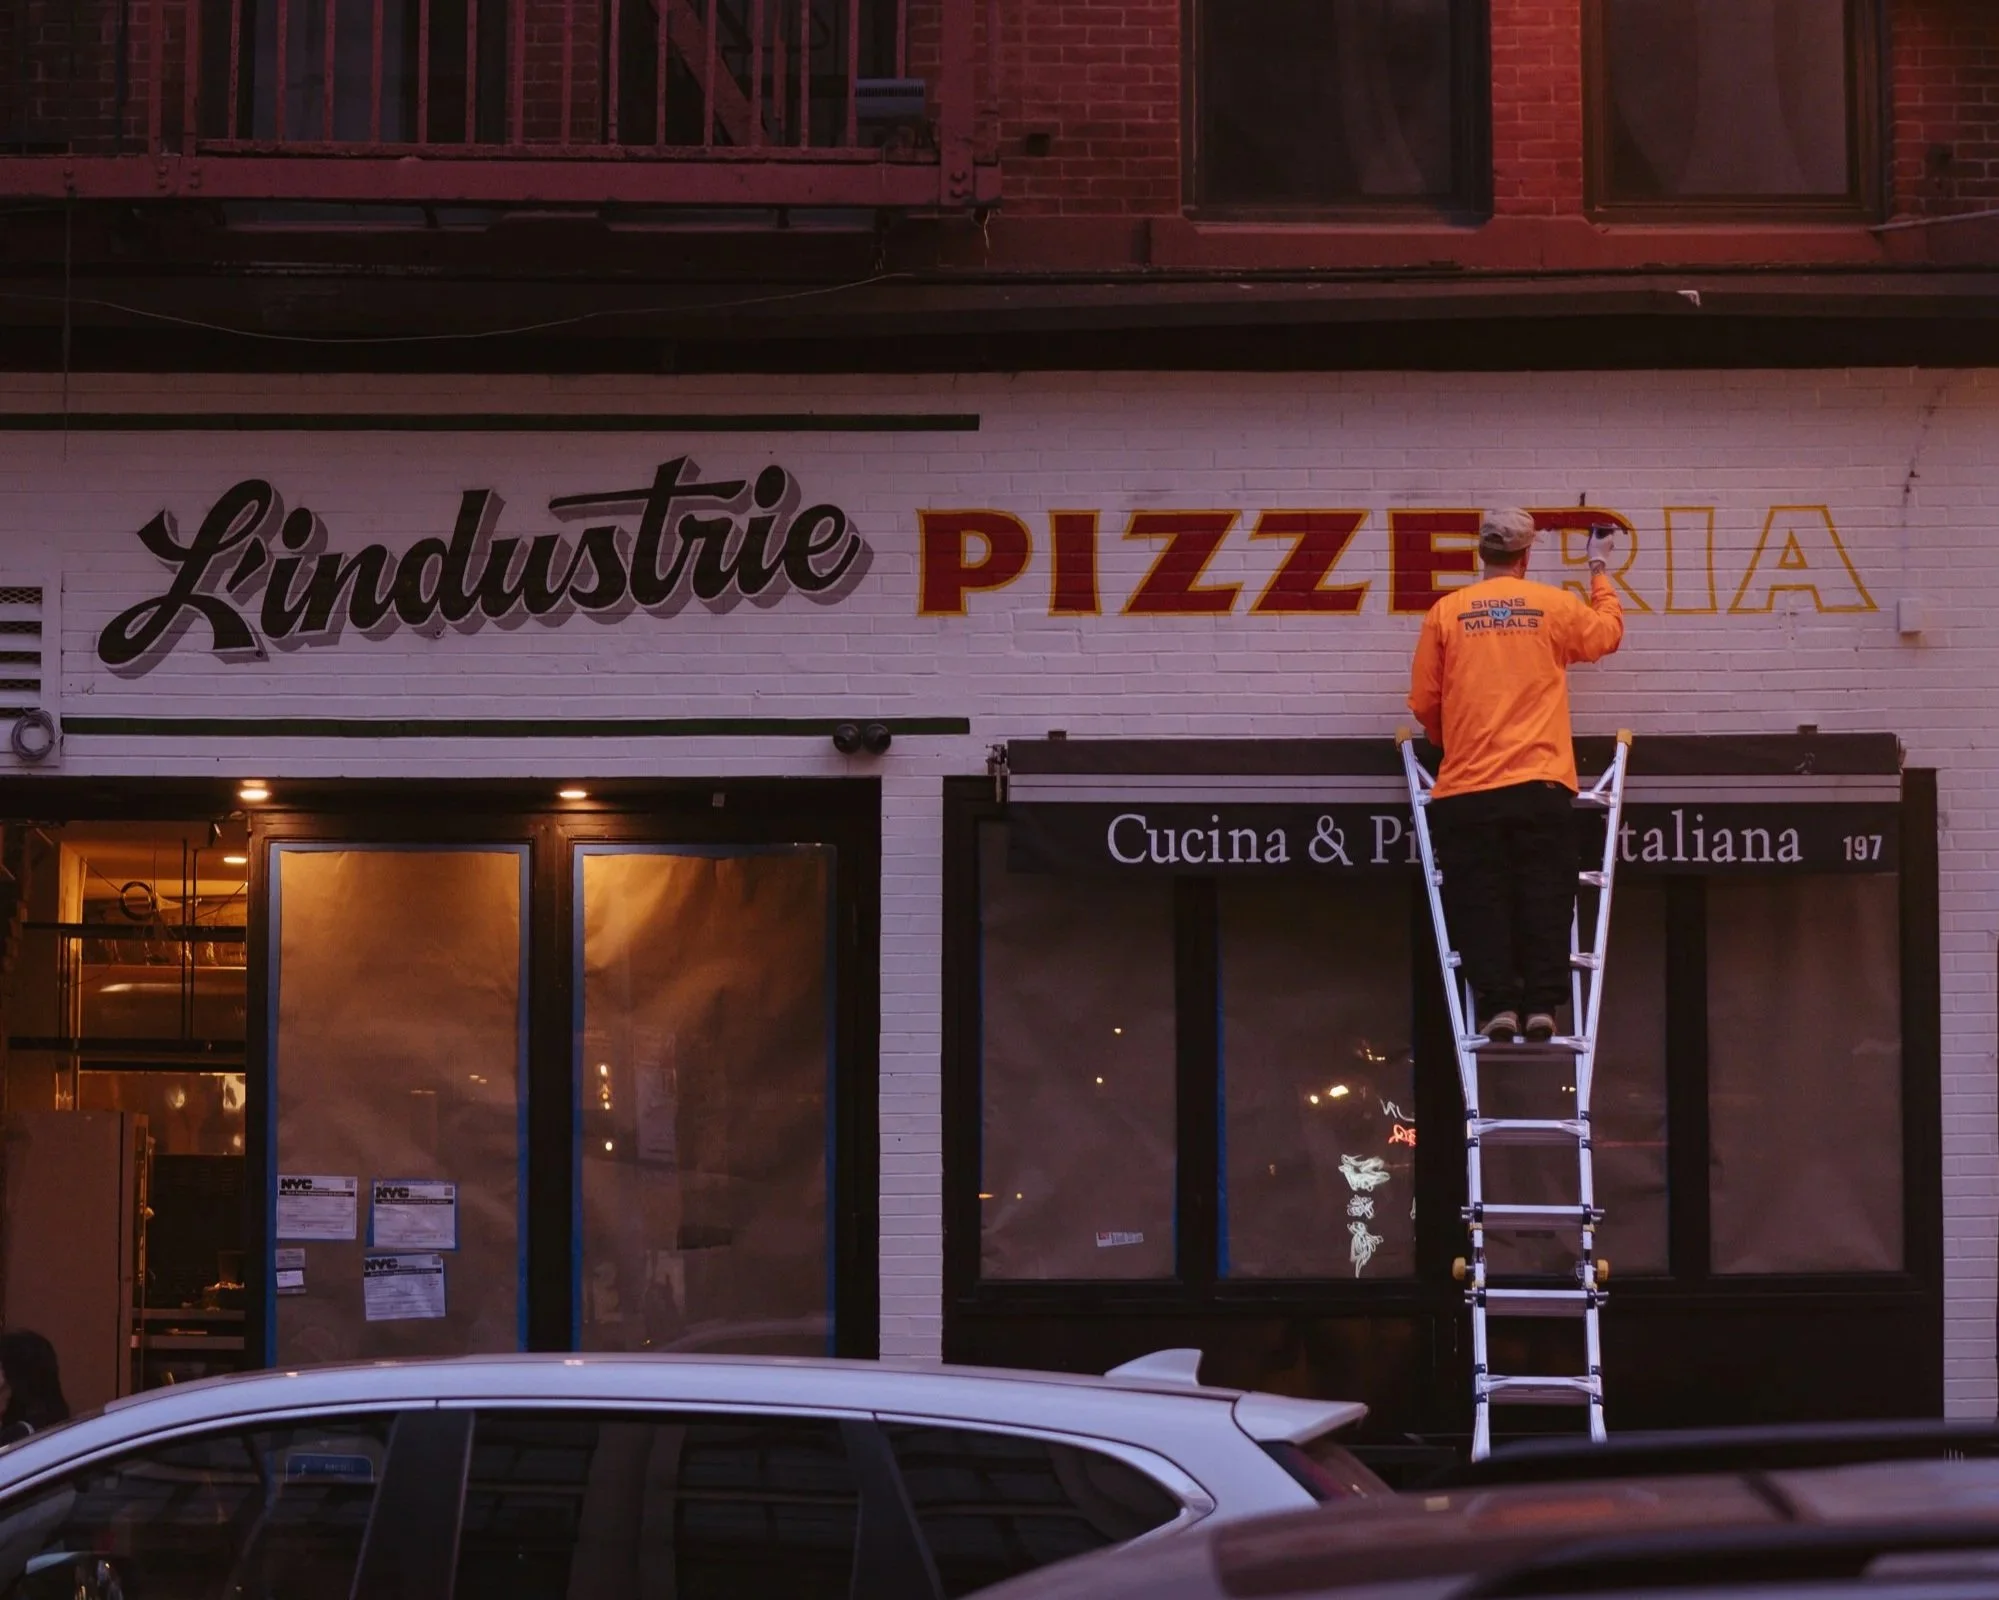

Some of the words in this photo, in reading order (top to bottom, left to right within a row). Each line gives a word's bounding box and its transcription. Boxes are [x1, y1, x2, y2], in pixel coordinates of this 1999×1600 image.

[916, 505, 1879, 616] PIZZERIA
[1471, 598, 1526, 609] SIGNS
[1465, 618, 1539, 631] MURALS
[1107, 813, 1291, 864] Cucina
[1308, 815, 1354, 866] &
[1601, 809, 1803, 862] taliana
[1843, 835, 1883, 861] 197
[281, 1179, 313, 1190] NYC
[375, 1186, 409, 1198] NYC
[364, 1258, 398, 1270] NYC
